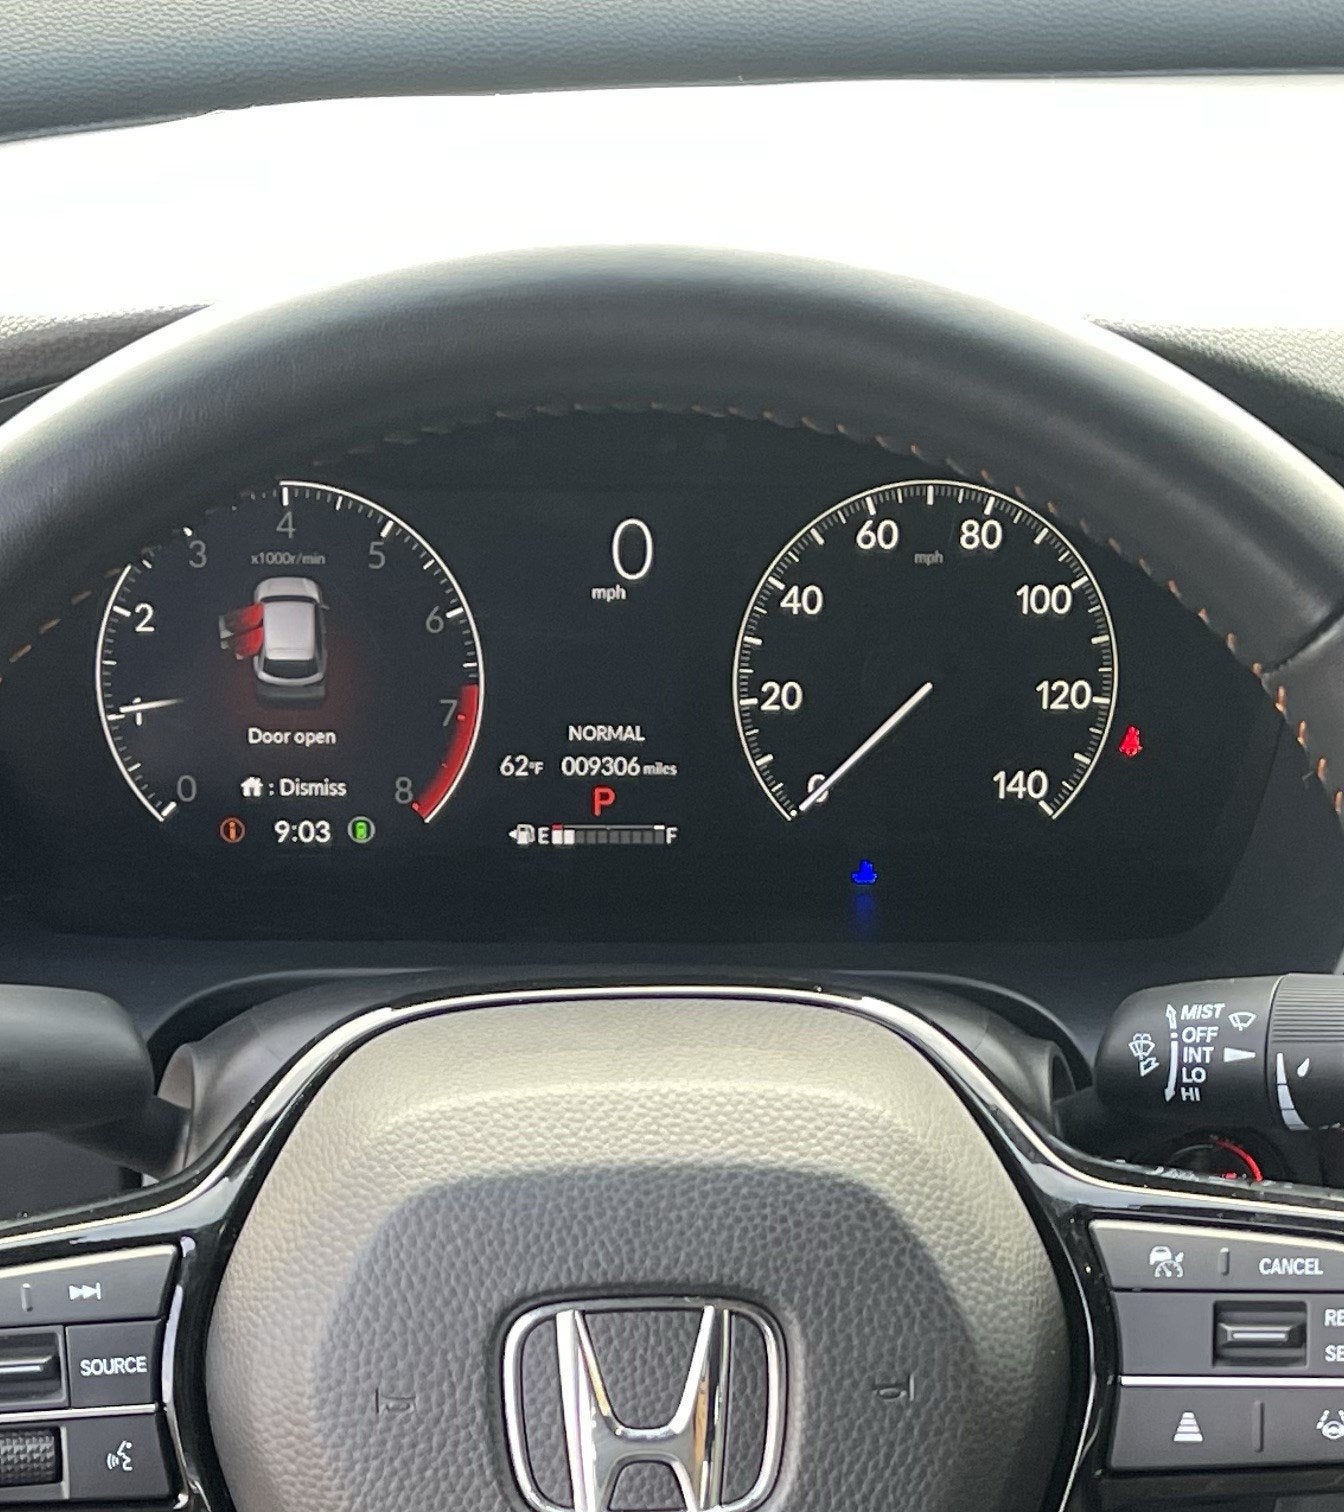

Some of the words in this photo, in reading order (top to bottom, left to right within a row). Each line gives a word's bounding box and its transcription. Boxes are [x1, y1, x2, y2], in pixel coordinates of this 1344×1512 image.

[276, 511, 296, 539] 4
[856, 520, 899, 549] 60
[960, 520, 1002, 549] 80
[188, 541, 207, 568] 3
[368, 541, 386, 568] 5
[612, 518, 653, 580] 0
[914, 550, 943, 565] mph
[591, 585, 626, 602] mph
[780, 585, 823, 615] 40
[1016, 585, 1072, 614] 100
[134, 605, 155, 633] 2
[425, 606, 445, 633] 6
[761, 682, 803, 711] 20
[1036, 681, 1091, 710] 120
[439, 699, 458, 726] 7
[248, 728, 287, 747] Door
[289, 730, 336, 749] open
[568, 725, 645, 742] NORMAL
[561, 755, 640, 777] 009306
[643, 761, 677, 775] miles
[177, 775, 197, 802] 0
[279, 778, 347, 797] Dismiss
[394, 777, 414, 804] 8
[993, 770, 1048, 799] 140
[592, 787, 616, 816] P
[274, 820, 331, 843] 9:03
[538, 828, 549, 845] E
[666, 827, 678, 845] F
[1181, 1003, 1225, 1020] MIST
[1182, 1027, 1218, 1043] OFF
[1183, 1047, 1214, 1064] INT
[1182, 1067, 1206, 1084] LO
[1181, 1087, 1200, 1101] HI
[1259, 1257, 1323, 1275] CANCEL
[80, 1356, 147, 1376] SOURCE
